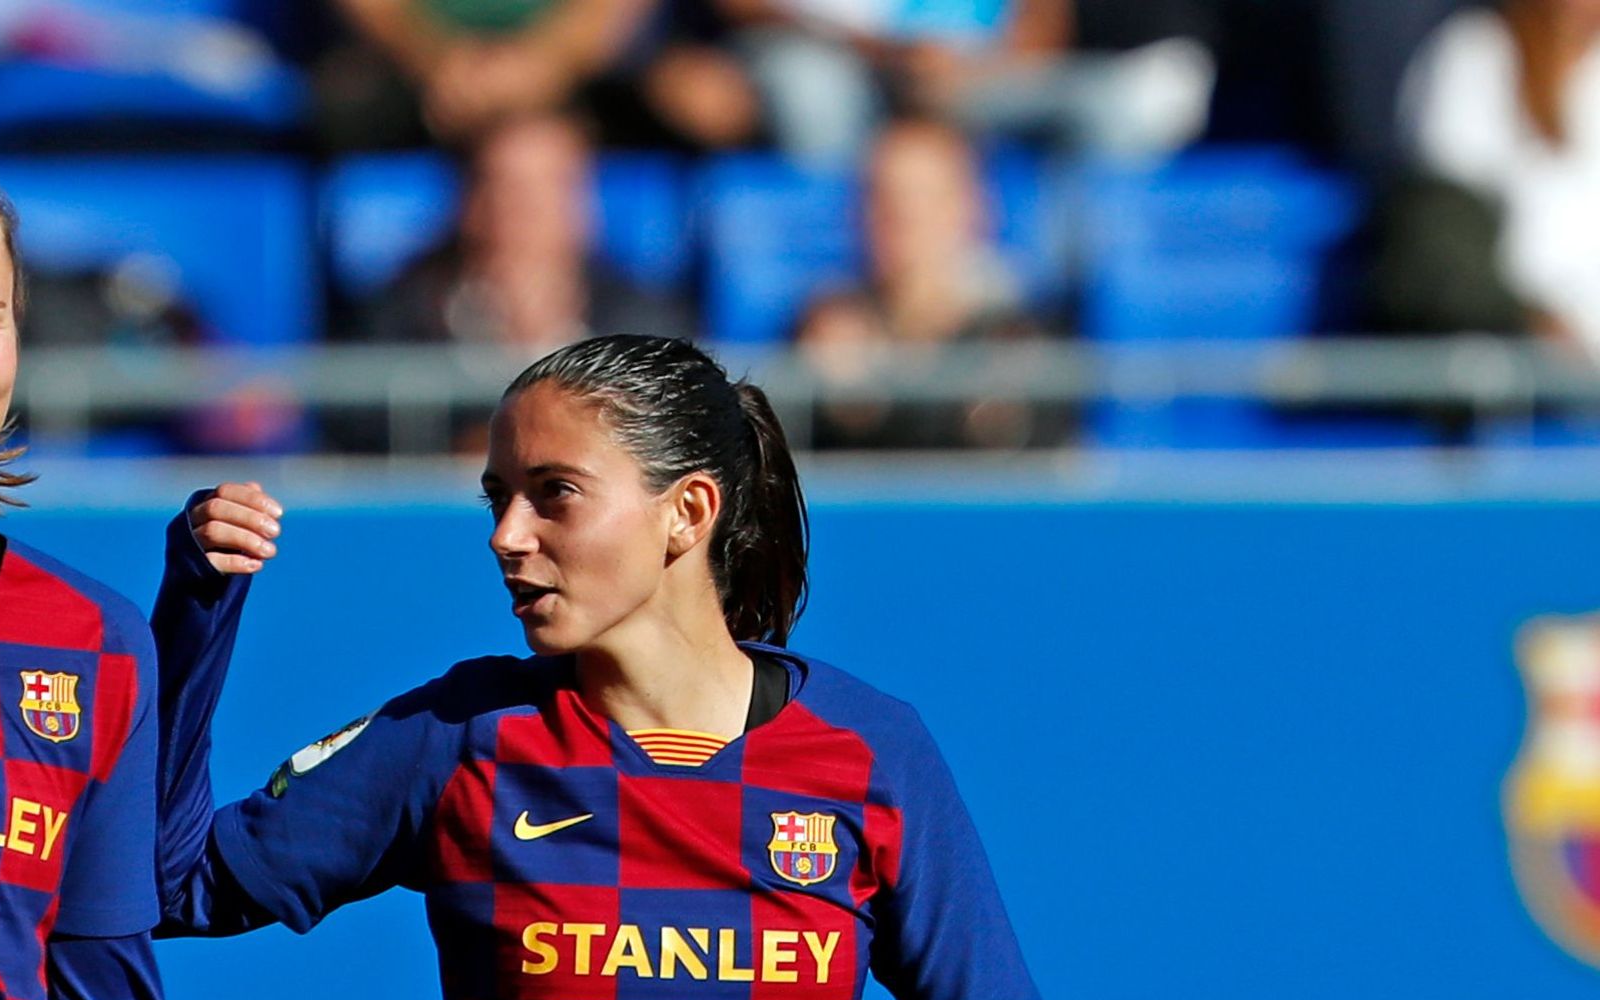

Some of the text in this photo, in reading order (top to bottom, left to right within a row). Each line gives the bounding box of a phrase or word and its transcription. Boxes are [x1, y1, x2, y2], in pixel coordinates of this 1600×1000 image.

[38, 701, 61, 711] FCB
[790, 842, 817, 851] FCB
[520, 921, 841, 984] STANLEY
